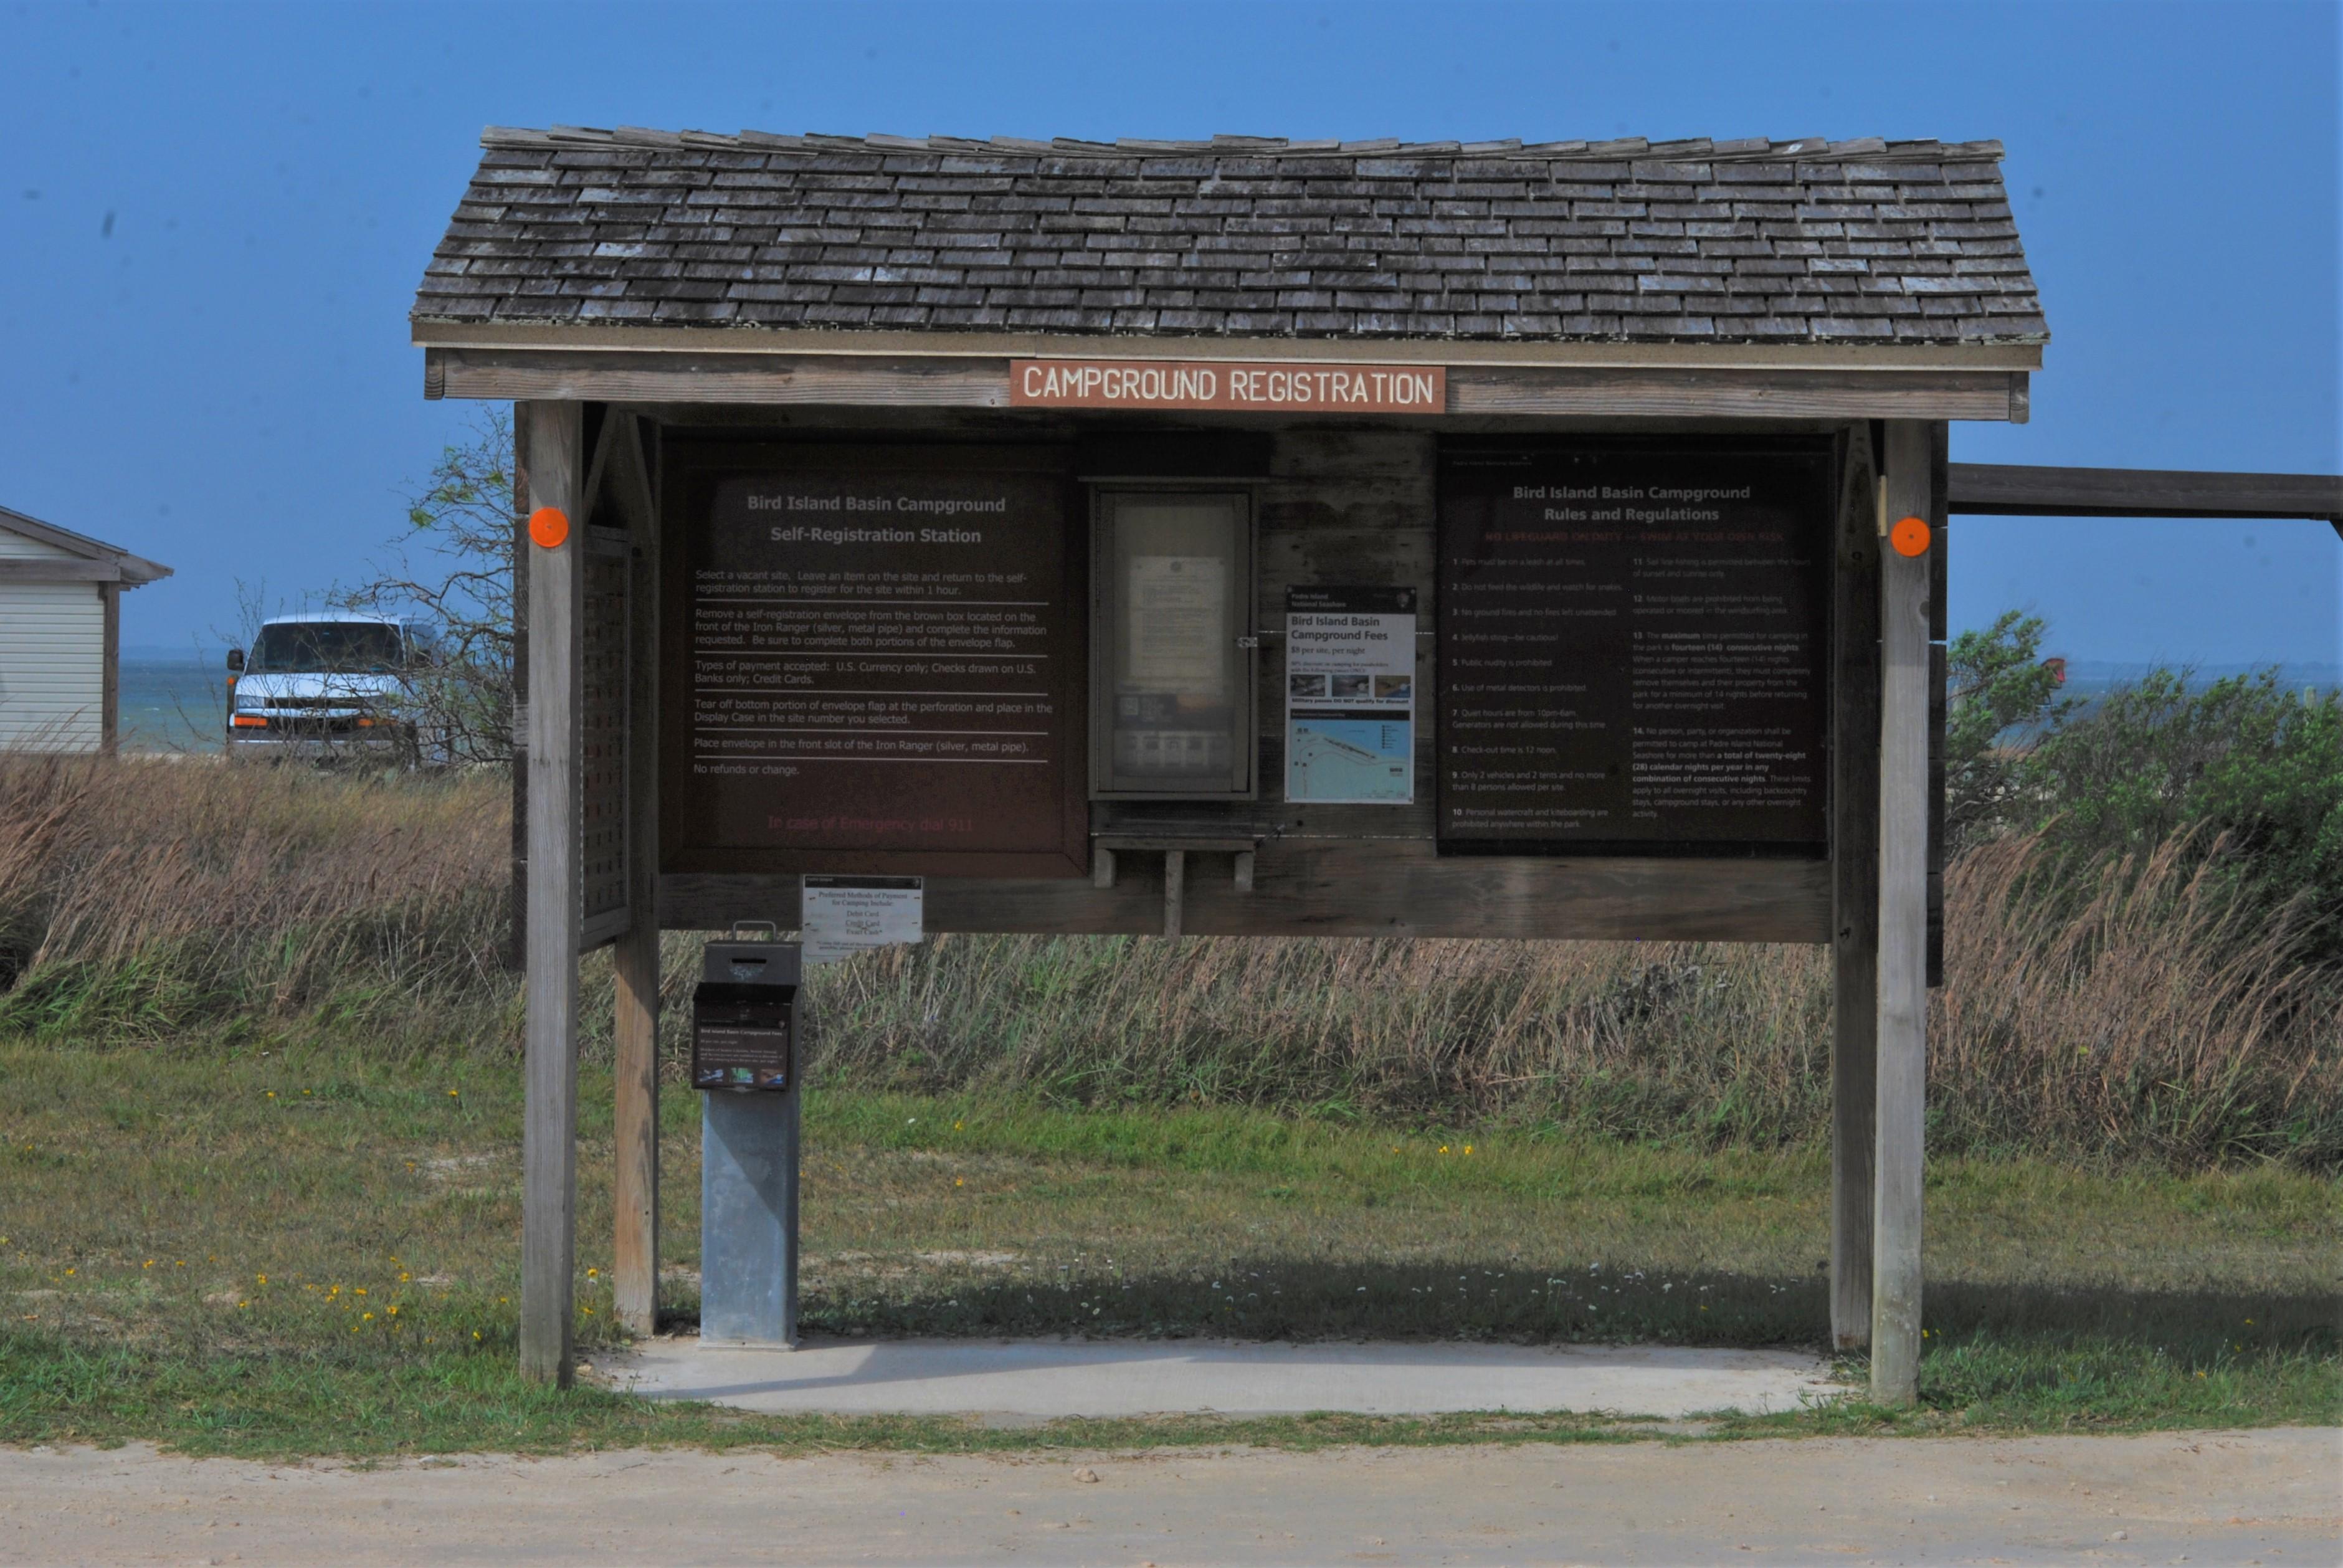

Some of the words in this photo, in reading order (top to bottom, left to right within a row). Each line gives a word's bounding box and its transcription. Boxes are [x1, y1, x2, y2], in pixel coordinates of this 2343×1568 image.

[1024, 367, 1216, 399] CAMPGROUND
[1230, 371, 1432, 403] REGISTRATION
[1513, 486, 1545, 498] Bird
[1550, 486, 1597, 498] Island
[1602, 486, 1643, 498] Basin
[1648, 486, 1750, 501] Campground
[748, 495, 781, 509] Bird
[787, 496, 840, 510] Island
[846, 497, 891, 510] Basin
[896, 497, 1005, 515] Campground
[1544, 508, 1587, 520] Rules
[1591, 507, 1620, 520] and
[1625, 507, 1719, 523] Regulations
[771, 526, 915, 544] Self-Registration
[920, 528, 981, 542] Station
[736, 571, 768, 579] vacant
[771, 571, 791, 580] site.
[797, 571, 826, 581] Leave
[844, 572, 865, 581] item
[882, 571, 899, 581] the
[901, 573, 919, 581] site
[921, 572, 939, 581] and
[942, 573, 972, 581] return
[974, 573, 985, 582] to
[987, 573, 1004, 582] the
[1006, 573, 1027, 582] self-
[696, 584, 750, 593] registration
[753, 584, 785, 592] station
[787, 584, 798, 593] to
[801, 584, 837, 596] register
[840, 584, 853, 594] for
[856, 584, 872, 594] the
[875, 585, 892, 594] site
[895, 585, 924, 594] within
[928, 586, 933, 594] 1
[936, 585, 961, 594] hour.
[696, 609, 734, 617] Remove
[746, 609, 820, 620] self-registration
[822, 610, 867, 620] envelope
[868, 610, 892, 620] from
[894, 611, 911, 620] the
[913, 611, 944, 620] brown
[946, 611, 964, 620] box
[967, 612, 1002, 621] located
[1019, 612, 1035, 621] the
[1291, 615, 1313, 625] Bird
[1316, 616, 1347, 625] Island
[1351, 617, 1379, 626] Basin
[695, 622, 718, 630] front
[721, 622, 731, 630] of
[734, 622, 749, 631] the
[753, 622, 772, 631] Iron
[776, 622, 810, 634] Ranger
[812, 623, 845, 633] (silver,
[848, 623, 875, 633] metal
[877, 624, 903, 635] pipe)
[905, 624, 923, 633] and
[926, 624, 971, 635] complete
[972, 624, 989, 634] the
[991, 624, 1047, 635] information
[1291, 629, 1361, 642] Campground
[1364, 630, 1388, 640] Fees
[696, 660, 723, 670] Types
[726, 660, 736, 670] of
[739, 662, 780, 671] payment
[783, 661, 829, 672] accepted:
[836, 662, 856, 671] U.S.
[858, 662, 902, 673] Currency
[905, 662, 928, 674] only;
[967, 663, 999, 673] drawn
[1000, 665, 1014, 673] on
[1016, 663, 1036, 673] U.S.
[695, 673, 723, 682] Banks
[726, 674, 749, 684] only;
[753, 673, 782, 683] Credit
[784, 673, 814, 683] Cards.
[695, 712, 728, 723] Display
[731, 712, 754, 721] Case
[769, 713, 785, 722] the
[787, 714, 805, 723] site
[807, 713, 845, 723] number
[847, 716, 865, 725] you
[867, 714, 910, 724] selected.
[1754, 752, 1805, 760] twenty-eight
[694, 764, 707, 772] No
[710, 764, 746, 774] refunds
[761, 765, 799, 776] change.
[1684, 763, 1709, 772] nights
